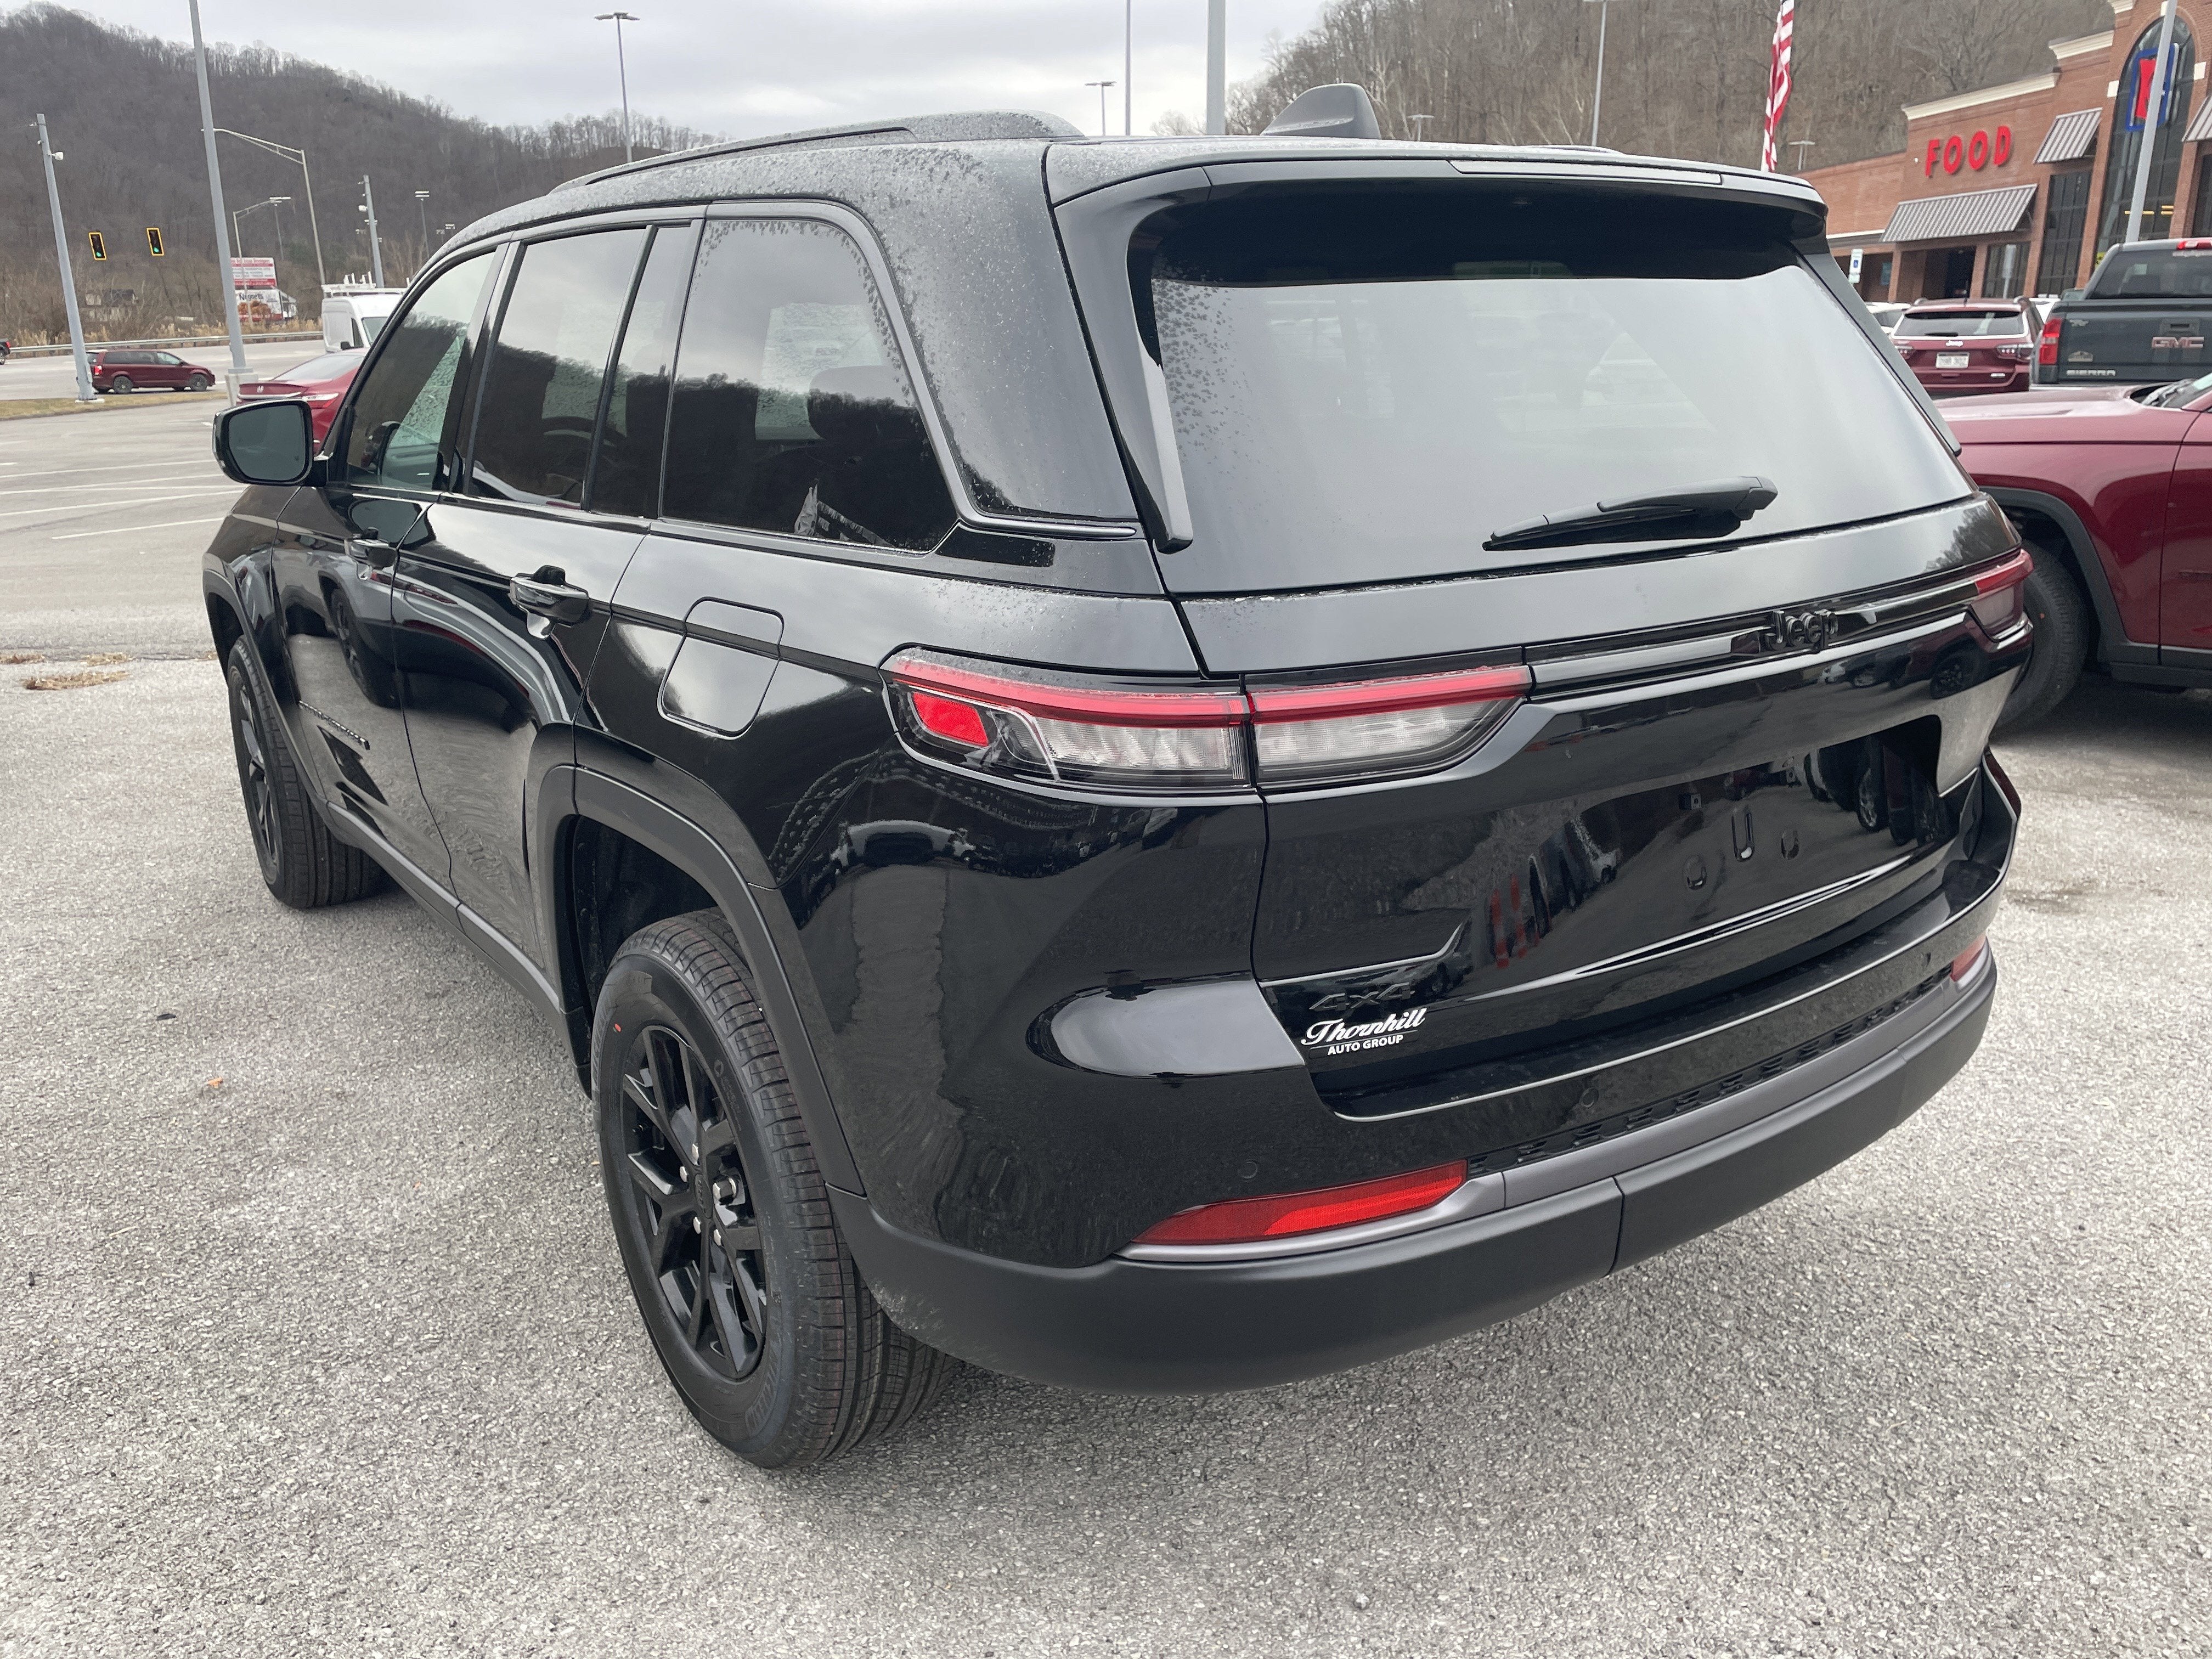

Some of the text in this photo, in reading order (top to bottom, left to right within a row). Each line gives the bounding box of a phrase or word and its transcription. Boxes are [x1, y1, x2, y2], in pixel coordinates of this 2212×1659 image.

[1925, 125, 2011, 176] FOOD
[2152, 336, 2204, 349] GMC
[1764, 608, 1838, 650] Jeep
[1309, 982, 1416, 1011] 4x4
[1301, 1008, 1427, 1045] Thornhill
[1328, 1034, 1404, 1056] AUTO GROUP
